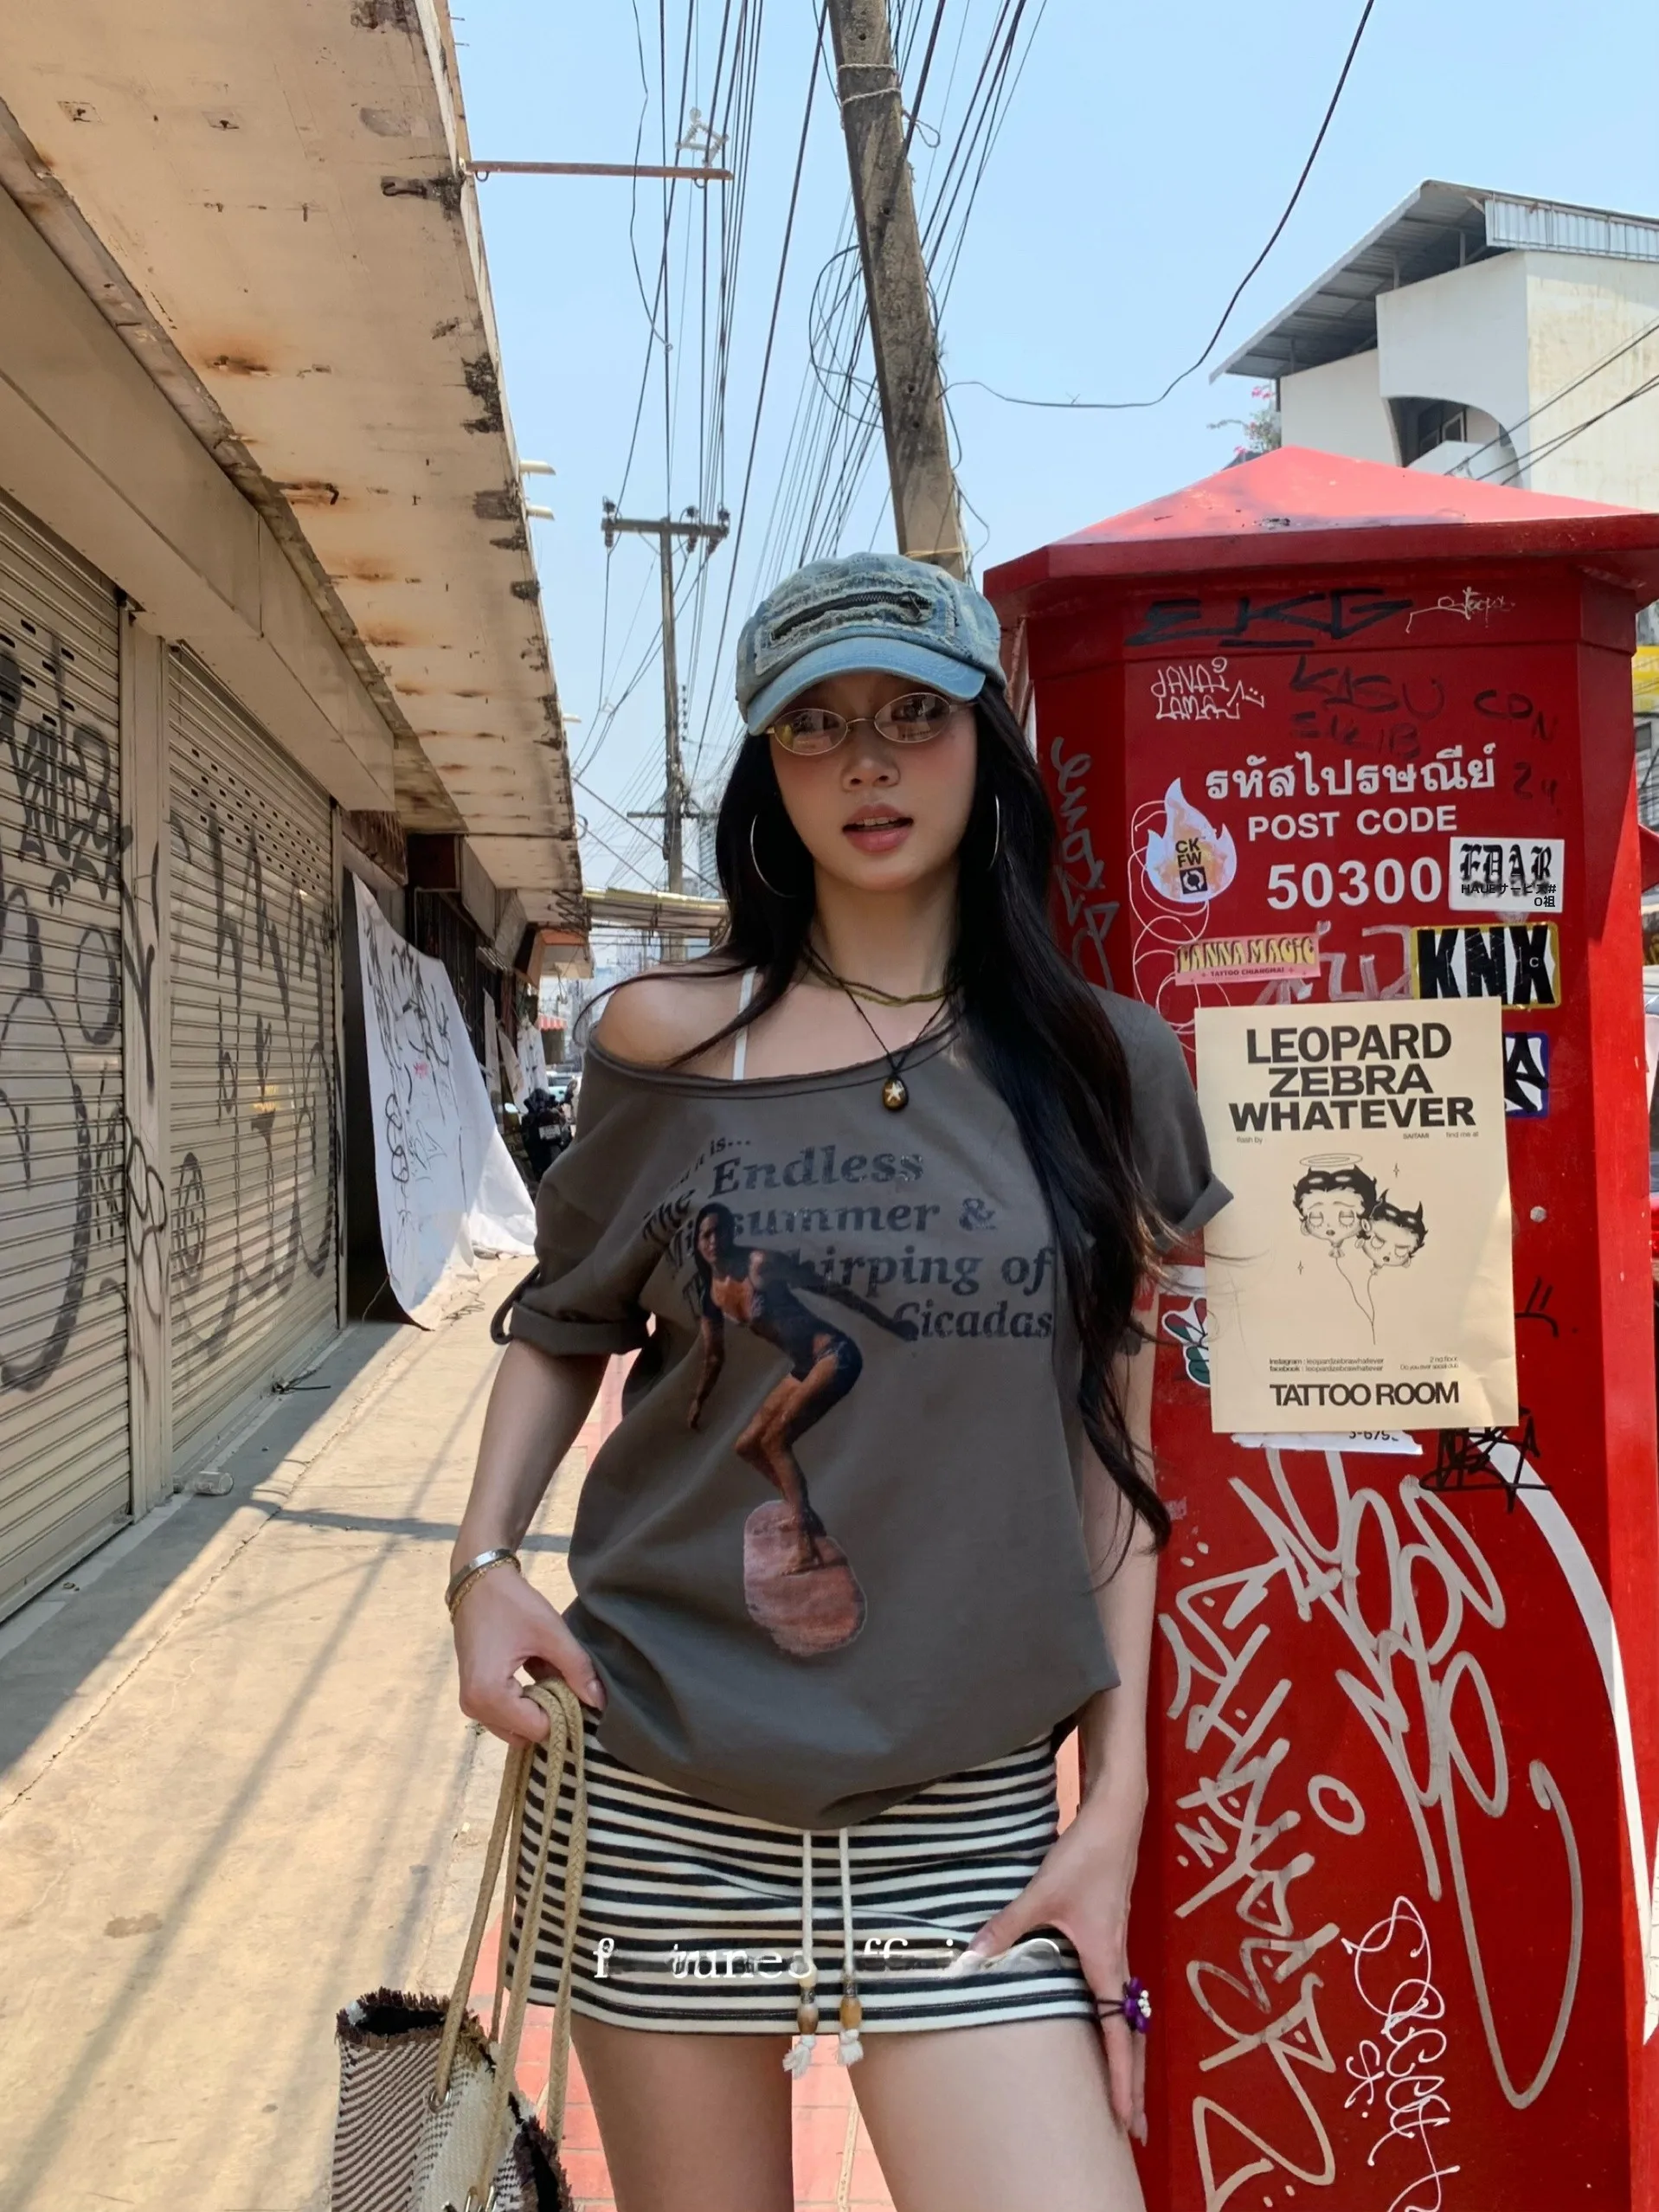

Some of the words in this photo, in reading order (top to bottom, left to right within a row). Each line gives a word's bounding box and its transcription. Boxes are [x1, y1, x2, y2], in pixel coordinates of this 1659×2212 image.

[1206, 743, 1495, 800] รหัสไปรษณีย์
[1248, 811, 1341, 841] POST
[1356, 805, 1457, 835] CODE
[1175, 837, 1200, 854] CK
[1177, 852, 1201, 868] FW
[1267, 857, 1443, 910] 50300
[1211, 969, 1239, 978] TATTOO
[1241, 967, 1284, 975] CHIANGMAI
[1246, 1022, 1452, 1064] LEOPARD
[1269, 1063, 1434, 1097] ZEBRA
[1229, 1096, 1476, 1132] WHATEVER
[707, 1144, 924, 1199] Endless
[957, 1197, 998, 1232] &
[1001, 1246, 1056, 1296] of
[1270, 1384, 1372, 1406] TATTOO
[1376, 1381, 1459, 1405] ROOM
